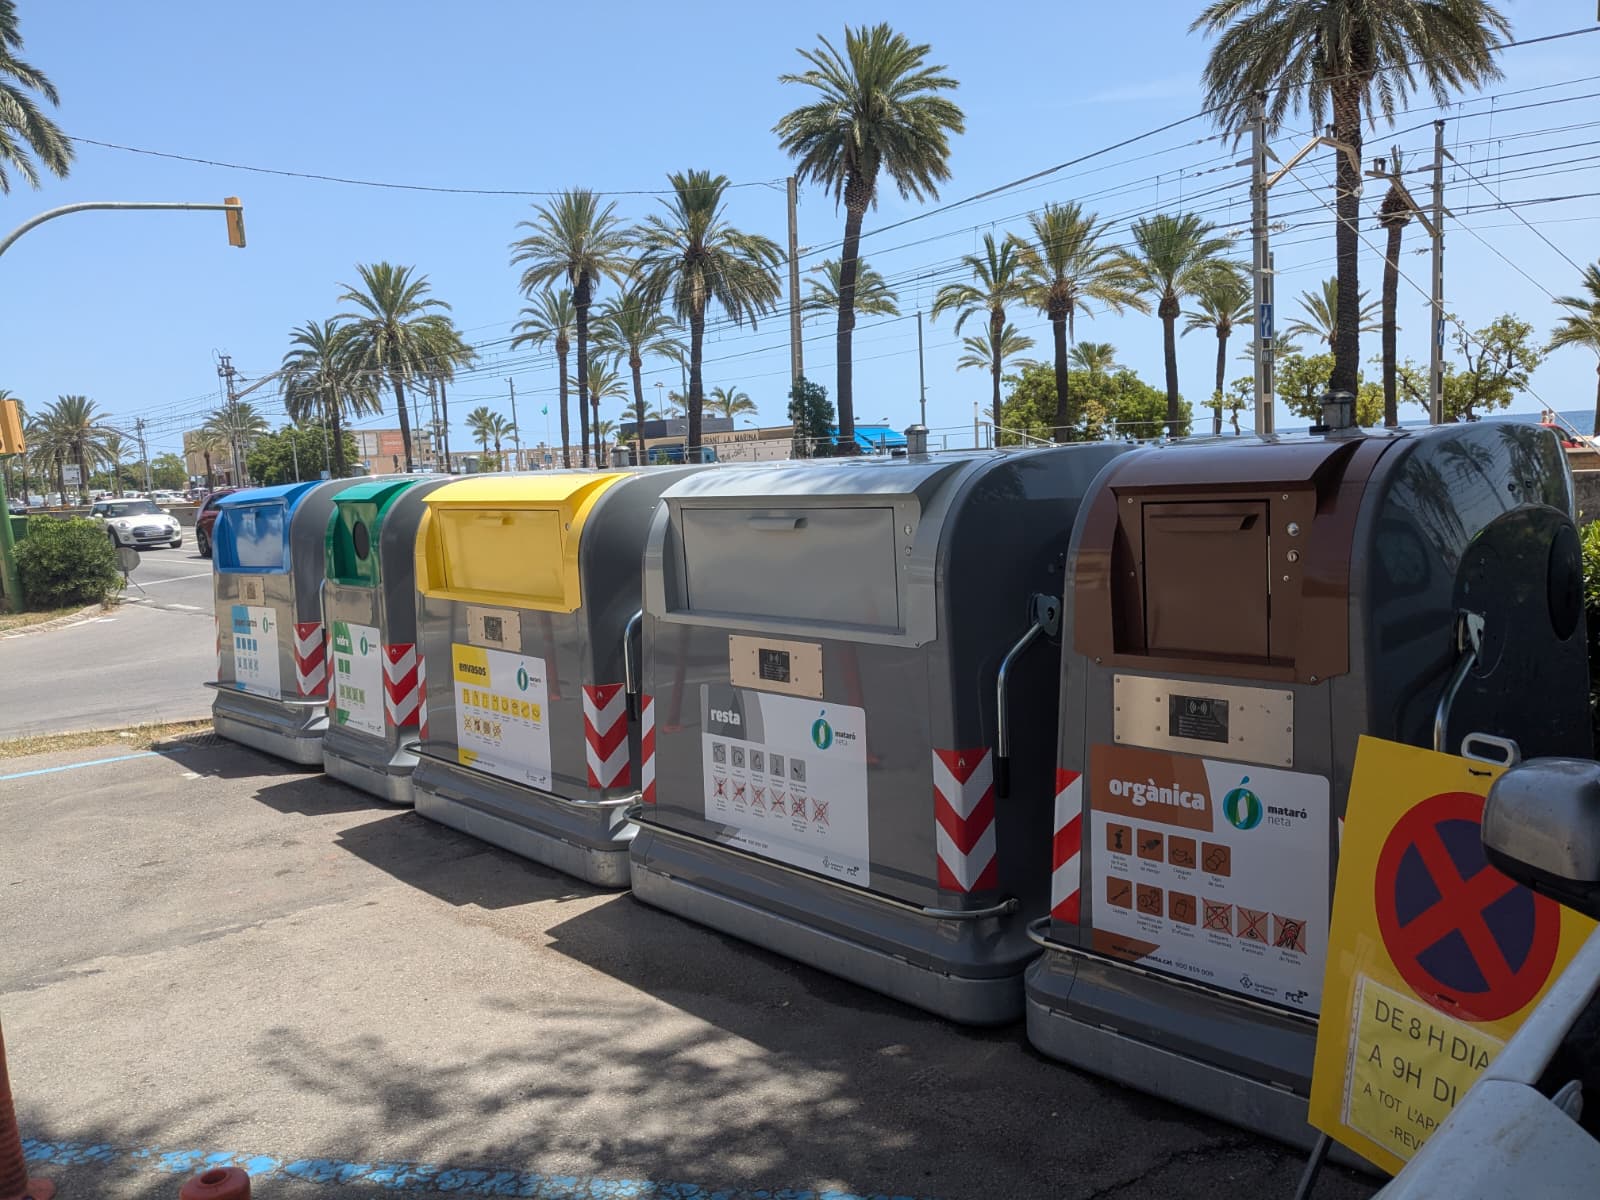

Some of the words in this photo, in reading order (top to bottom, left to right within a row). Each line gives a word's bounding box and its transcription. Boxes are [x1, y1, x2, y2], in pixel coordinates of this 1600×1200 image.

[735, 433, 758, 442] MARINA
[459, 662, 487, 676] envasos
[711, 708, 741, 725] resta
[835, 730, 856, 741] mataró
[1108, 778, 1206, 811] orgànica
[1267, 804, 1308, 819] mataró
[1267, 814, 1292, 828] neta
[1376, 1000, 1404, 1032] DE
[1409, 1018, 1421, 1040] 8
[1428, 1025, 1445, 1052] H
[1451, 1037, 1489, 1071] DIA
[1368, 1044, 1383, 1068] A
[1393, 1057, 1422, 1089] 9H
[1433, 1077, 1467, 1108] DI
[1363, 1082, 1373, 1097] A
[1378, 1089, 1403, 1113] TOT
[1390, 1126, 1427, 1151] -REV
